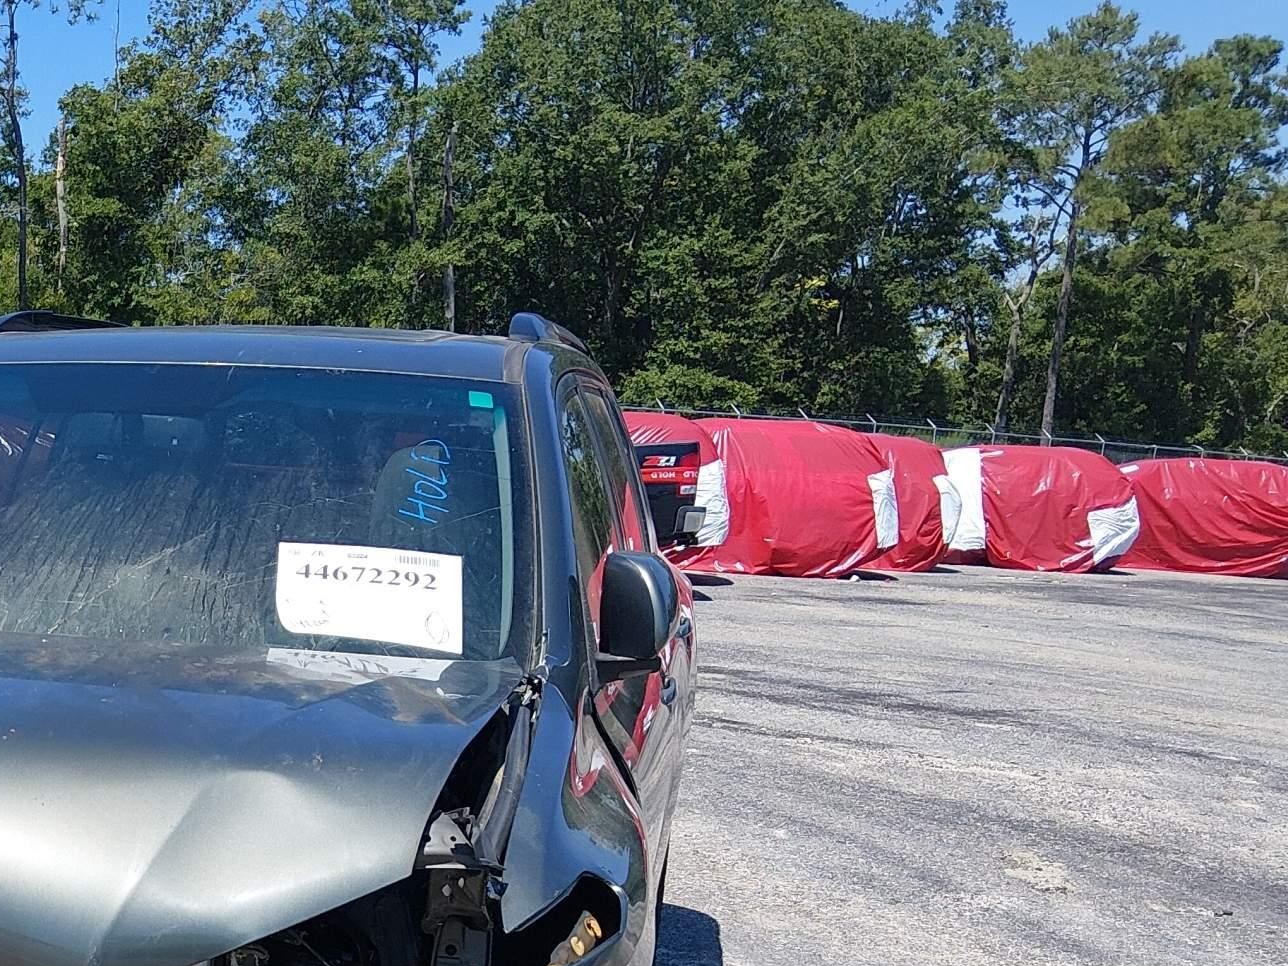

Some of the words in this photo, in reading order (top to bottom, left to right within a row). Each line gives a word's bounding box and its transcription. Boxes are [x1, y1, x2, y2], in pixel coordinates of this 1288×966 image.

[398, 438, 451, 524] HOLD
[650, 471, 676, 479] HOLD
[295, 563, 438, 591] 44672292
